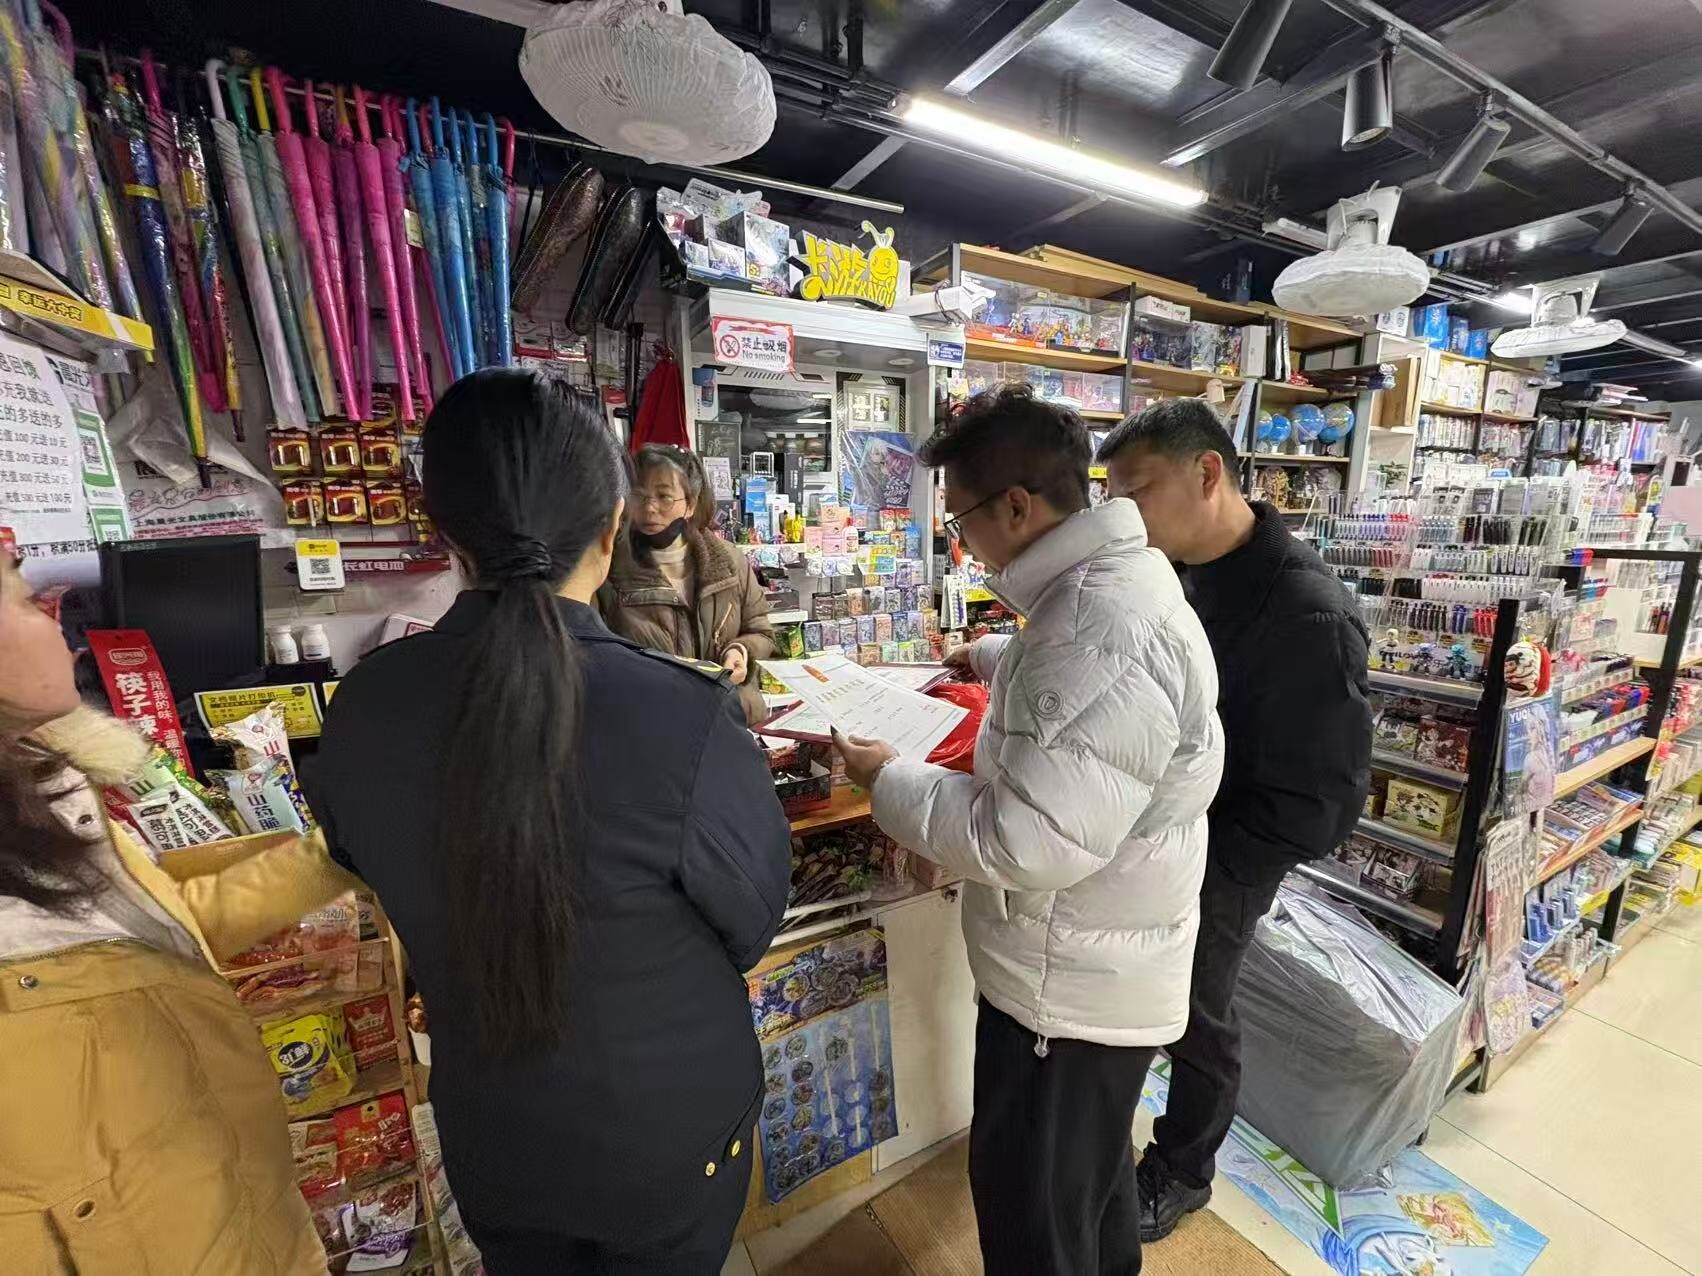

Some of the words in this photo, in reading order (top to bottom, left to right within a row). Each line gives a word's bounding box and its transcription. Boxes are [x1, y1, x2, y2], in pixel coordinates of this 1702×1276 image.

[859, 279, 897, 309] KAYOU
[742, 337, 787, 353] 禁止吸烟
[742, 350, 753, 359] No
[754, 352, 786, 363] smoking
[344, 561, 404, 571] 长虹电池
